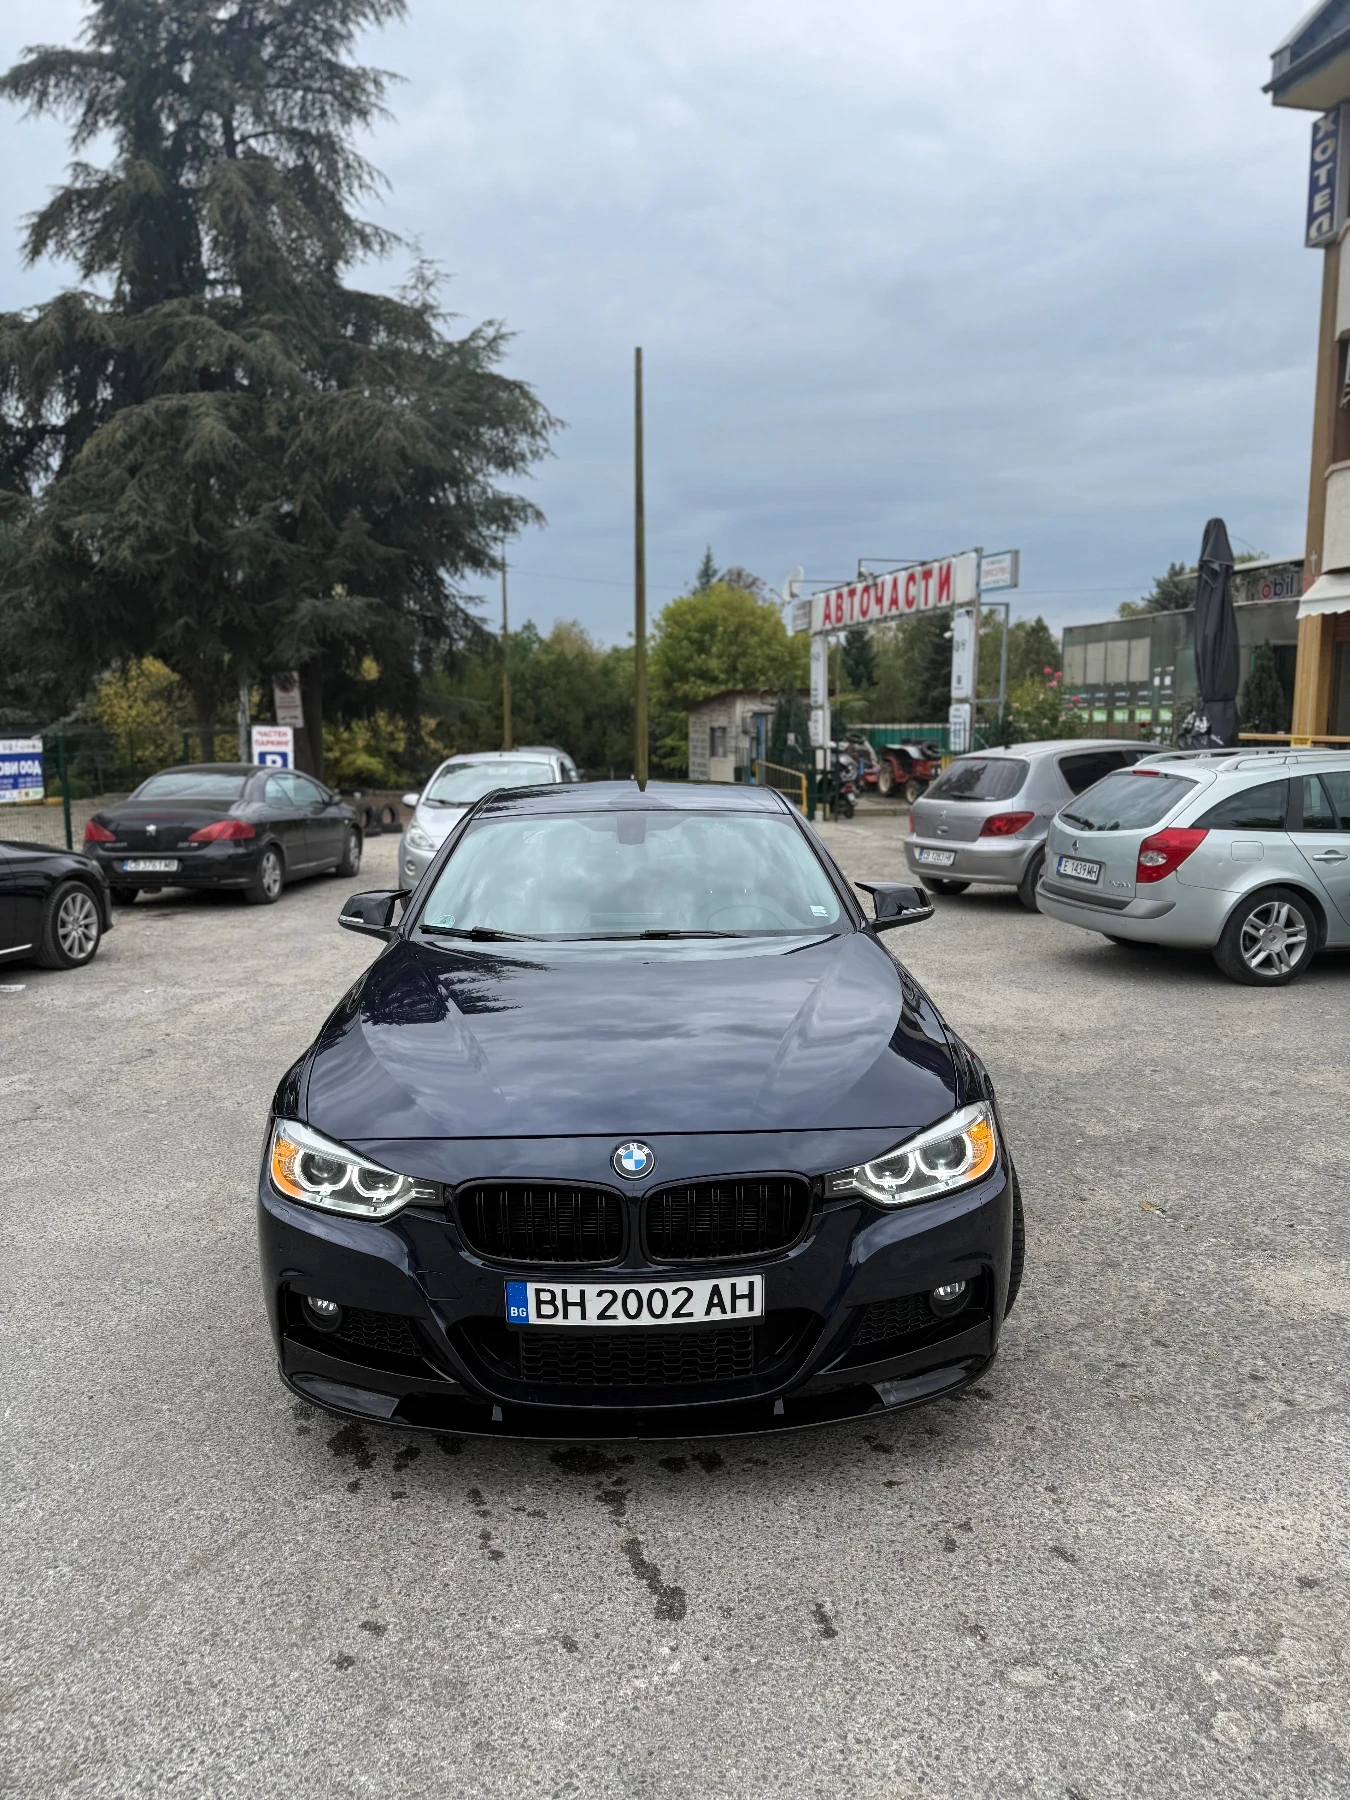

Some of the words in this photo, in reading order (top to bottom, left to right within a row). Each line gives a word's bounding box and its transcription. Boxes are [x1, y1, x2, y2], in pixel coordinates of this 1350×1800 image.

[1309, 111, 1337, 240] ХОТЕЛ
[822, 562, 953, 627] АВТОЧАСТИ
[254, 739, 290, 747] ПАРКИНГ
[20, 759, 42, 776] ООД
[1063, 859, 1070, 872] E
[1070, 861, 1087, 876] 1439
[1086, 864, 1099, 879] MH
[534, 1286, 588, 1321] BH
[595, 1286, 695, 1320] 2002
[703, 1280, 755, 1317] AH
[510, 1306, 527, 1317] BG
